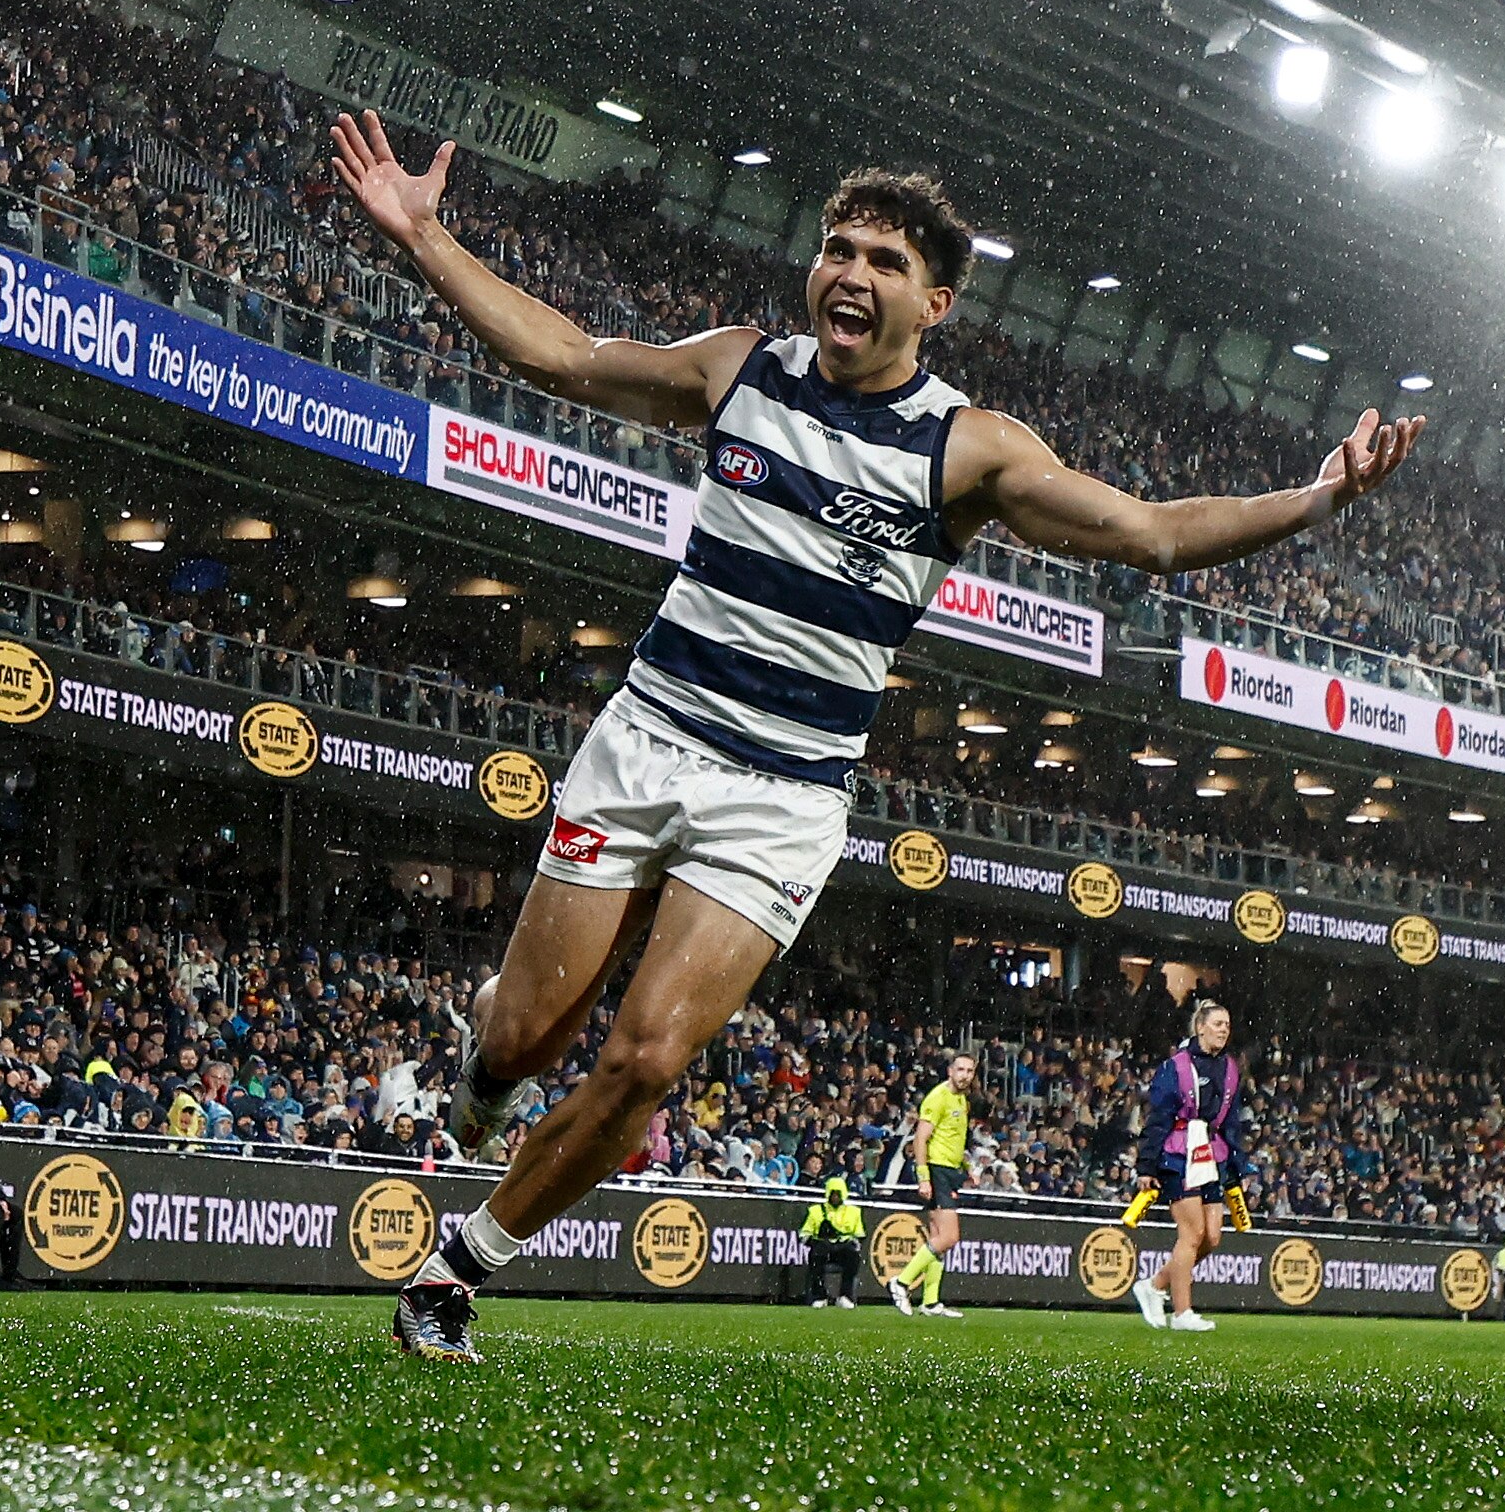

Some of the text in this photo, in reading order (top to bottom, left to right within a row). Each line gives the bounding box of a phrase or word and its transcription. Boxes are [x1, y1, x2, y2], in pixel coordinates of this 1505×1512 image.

[474, 99, 559, 164] STAND
[148, 333, 183, 384] the
[188, 347, 228, 413] key
[229, 367, 250, 410] to
[252, 385, 302, 432] your
[302, 399, 416, 476] community
[444, 421, 668, 528] SHOJUN CONCRETE
[718, 448, 761, 482] AFL
[820, 491, 925, 547] Ford
[995, 591, 1093, 648] CONCRETE
[1230, 667, 1293, 709] Riordan
[60, 679, 234, 744] STATE TRANSPORT
[1349, 696, 1406, 736] Riordan
[258, 722, 299, 746] STATE
[321, 733, 474, 790] STATE TRANSPORT
[495, 770, 532, 791] STATE
[842, 838, 885, 865] SPORT
[950, 854, 1065, 896] STATE TRANSPORT
[1124, 884, 1231, 923] STATE TRANSPORT
[1287, 911, 1388, 947] STATE TRANSPORT
[1440, 935, 1471, 959] STATE
[49, 1189, 100, 1218] STATE
[128, 1192, 338, 1248] STATE TRANSPORT
[370, 1208, 414, 1234] STATE
[51, 1224, 95, 1238] TRANSPORT
[518, 1218, 621, 1260] RANSPORT
[652, 1226, 690, 1246] STATE
[712, 1226, 763, 1264] STATE
[886, 1236, 917, 1255] STATE
[982, 1241, 1072, 1277] TRANSPORT
[1093, 1248, 1122, 1267] STATE
[1324, 1260, 1436, 1293] STATE TRANSPORT
